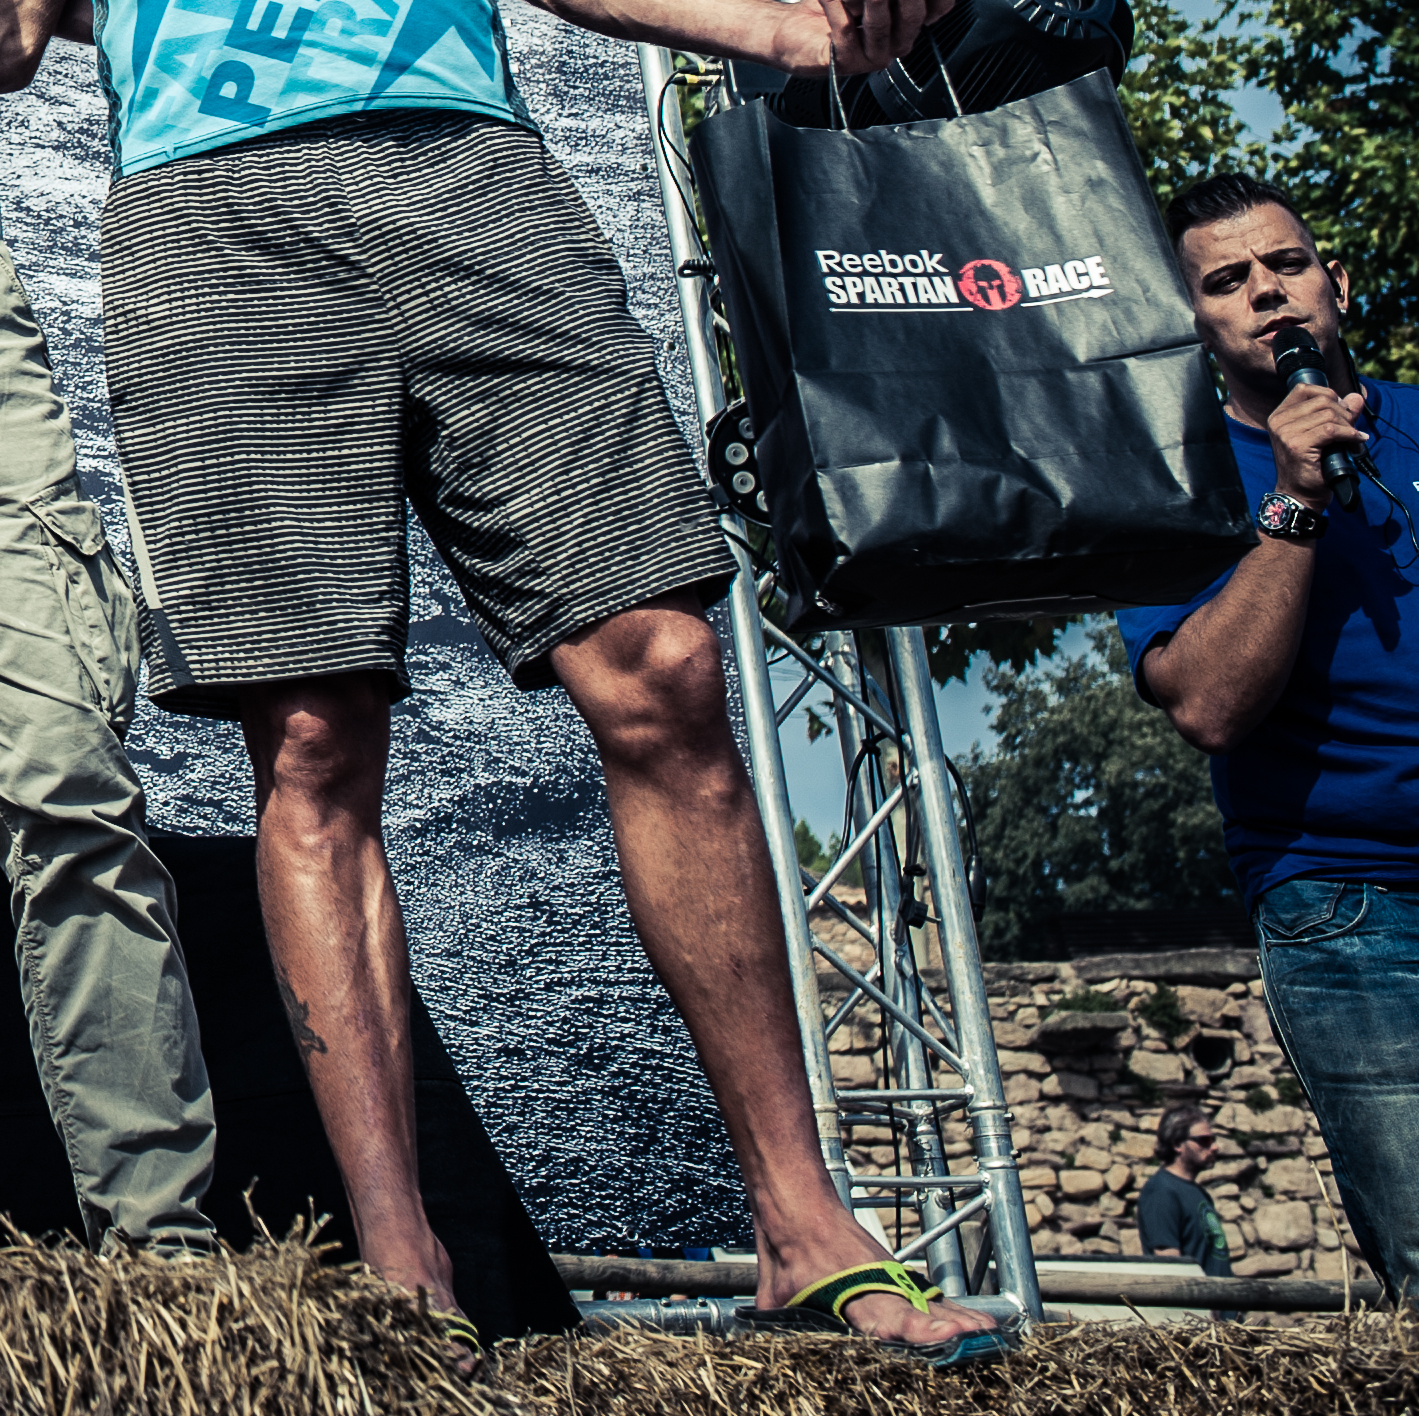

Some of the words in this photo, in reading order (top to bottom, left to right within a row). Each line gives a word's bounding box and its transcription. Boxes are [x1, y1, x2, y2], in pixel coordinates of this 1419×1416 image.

[815, 249, 949, 274] Reebok
[824, 275, 960, 304] SPARTAN
[1021, 255, 1110, 298] RACE
